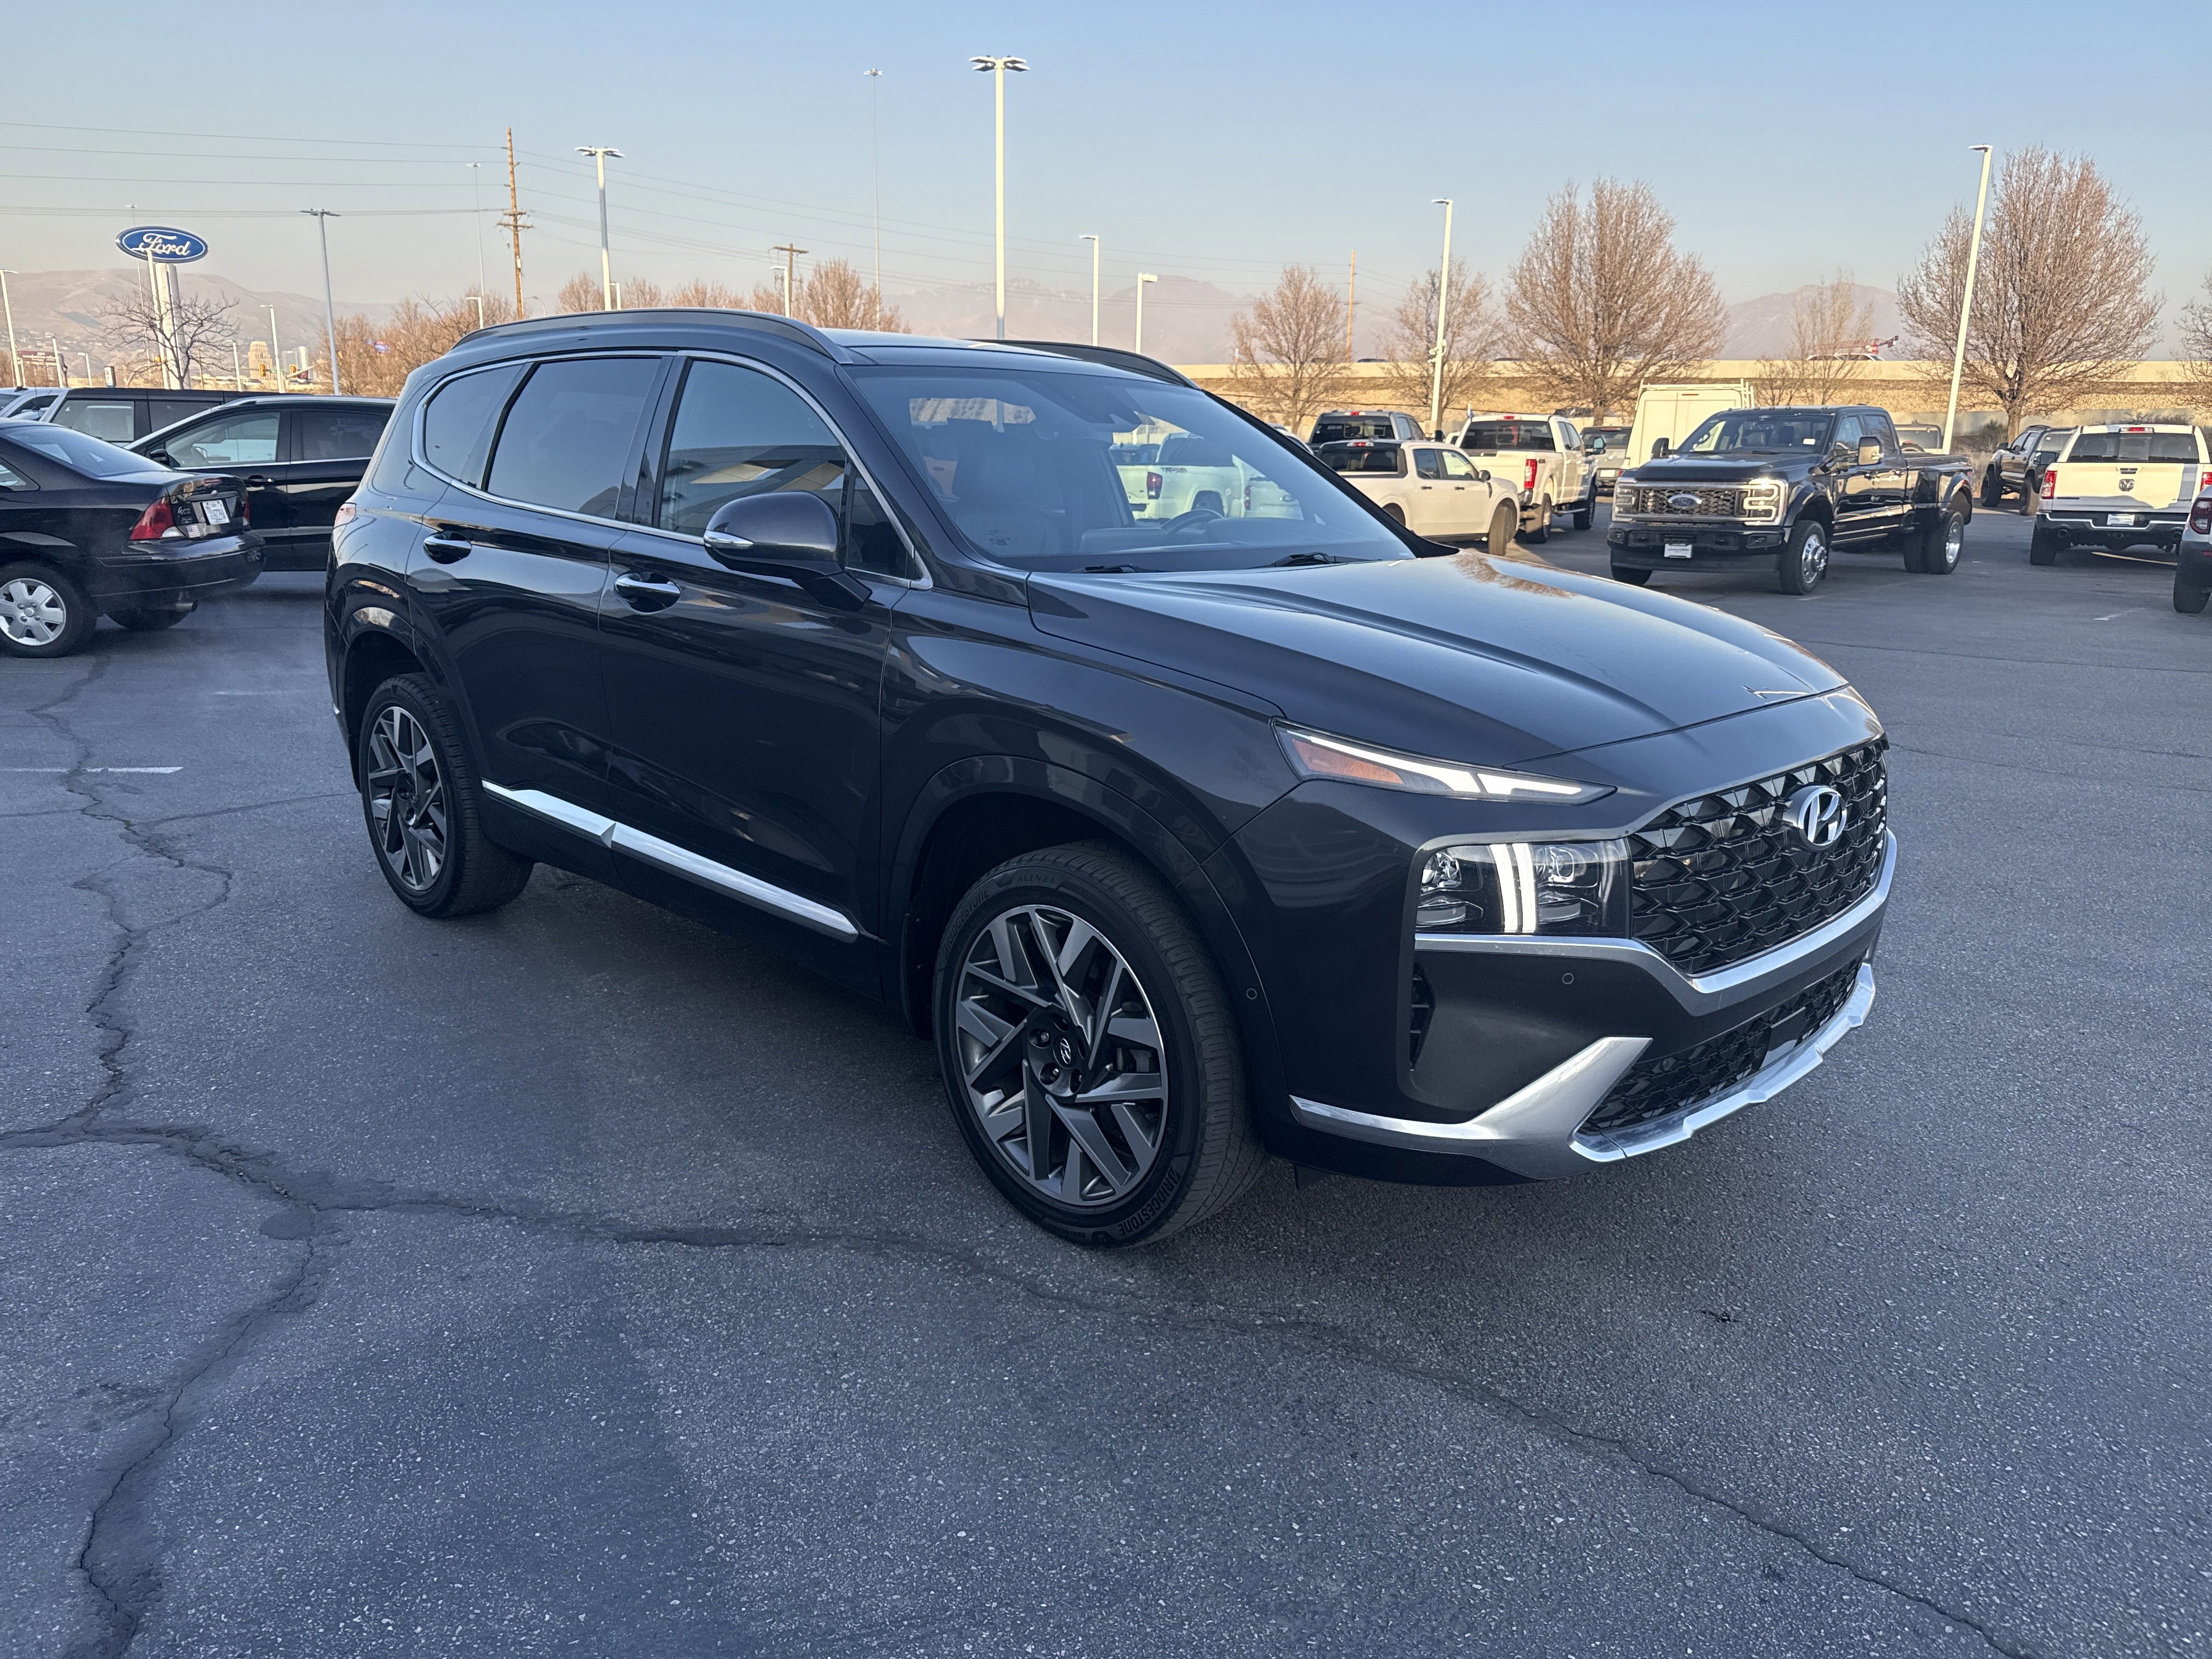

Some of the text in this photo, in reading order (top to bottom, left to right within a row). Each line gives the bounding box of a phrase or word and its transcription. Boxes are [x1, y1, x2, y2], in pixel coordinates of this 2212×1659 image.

[139, 233, 191, 256] Ford
[1018, 874, 1054, 884] ALENZA
[1117, 1165, 1181, 1236] BRIDGESTONE
